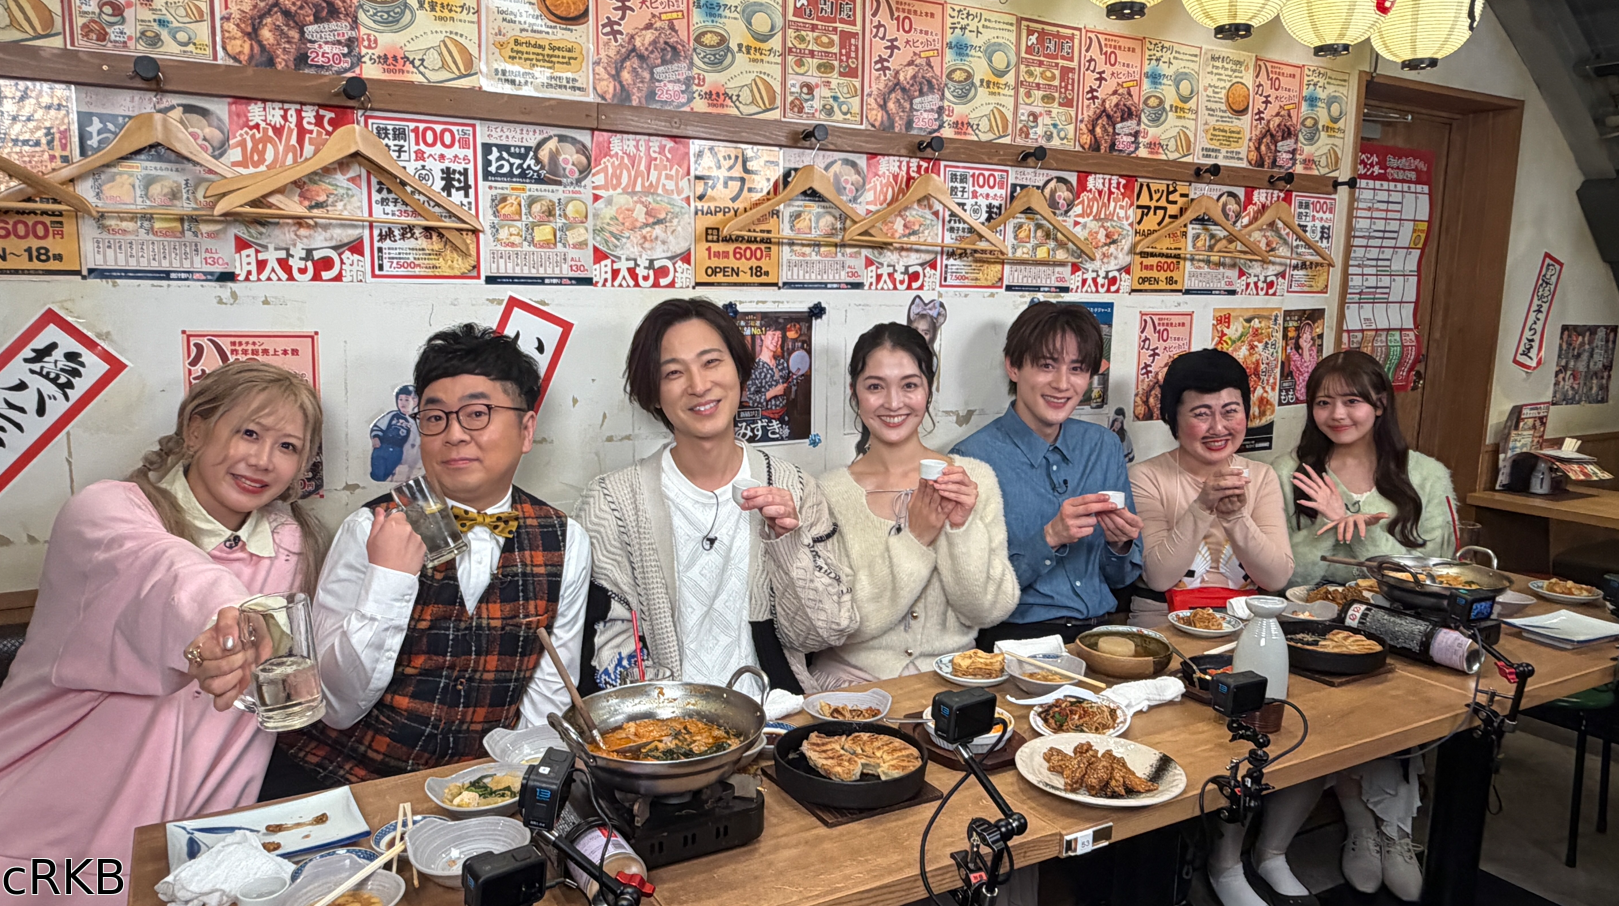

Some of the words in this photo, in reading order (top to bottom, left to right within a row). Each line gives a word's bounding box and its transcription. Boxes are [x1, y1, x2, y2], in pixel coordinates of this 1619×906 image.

[417, 0, 479, 15] 黒蜜きなこプリン
[495, 6, 523, 19] Today's
[692, 1, 740, 15] 塩バニラアイス
[948, 6, 982, 23] こだわり
[501, 17, 517, 25] Make
[530, 28, 550, 36] deserve
[948, 21, 983, 38] デザート
[510, 48, 525, 56] Enjoy
[513, 38, 546, 52] Birthday
[547, 43, 577, 54] Special:
[736, 43, 781, 58] 黒蜜きなこプリン
[945, 41, 983, 54] 塩バニラアイス
[1147, 40, 1174, 56] こだわり
[308, 50, 351, 67] 250円
[359, 53, 428, 70] どら焼きアイス
[535, 57, 555, 65] birthday
[1147, 54, 1174, 69] デザート
[1210, 53, 1221, 62] Hot
[1226, 56, 1245, 69] Crispy!
[1305, 67, 1328, 80] こだわり
[978, 78, 1016, 91] 黒蜜きなこプリン
[1305, 80, 1327, 93] デザート
[656, 88, 688, 104] 250円
[247, 102, 336, 132] 美味すぎて
[375, 125, 407, 144] 鉄鍋
[410, 126, 471, 150] 100個
[1212, 126, 1228, 134] Birthday
[609, 135, 675, 160] 美味すぎて
[413, 148, 472, 166] 食べきったら
[487, 146, 541, 175] おでん
[694, 146, 779, 175] ハッピー
[878, 156, 929, 178] 美味すぎて
[417, 173, 430, 183] 60
[525, 170, 547, 181] フェア
[950, 172, 968, 186] 鉄鍋
[970, 172, 1005, 190] 100個
[1086, 173, 1126, 194] 美味すぎて
[950, 186, 968, 199] 餃子
[970, 189, 1005, 202] 食べきったら
[1136, 182, 1190, 206] ハッピー
[695, 205, 744, 218] HAPPY
[0, 219, 64, 240] 600円
[203, 257, 229, 266] 130円
[705, 245, 730, 261] 1時間
[733, 246, 774, 262] 600円
[234, 242, 366, 282] 明太もつ鍋
[569, 264, 589, 273] 130円
[593, 254, 693, 288] 明太もつ鍋
[863, 262, 939, 292] 明太もつ鍋
[1070, 267, 1132, 294] 明太もつ鍋
[1236, 274, 1286, 296] 明太もつ鍋
[230, 340, 265, 348] 博多チキン
[230, 347, 300, 357] 昨年総売上本数
[1140, 316, 1161, 379] ハカチキ
[735, 418, 782, 441] みずき
